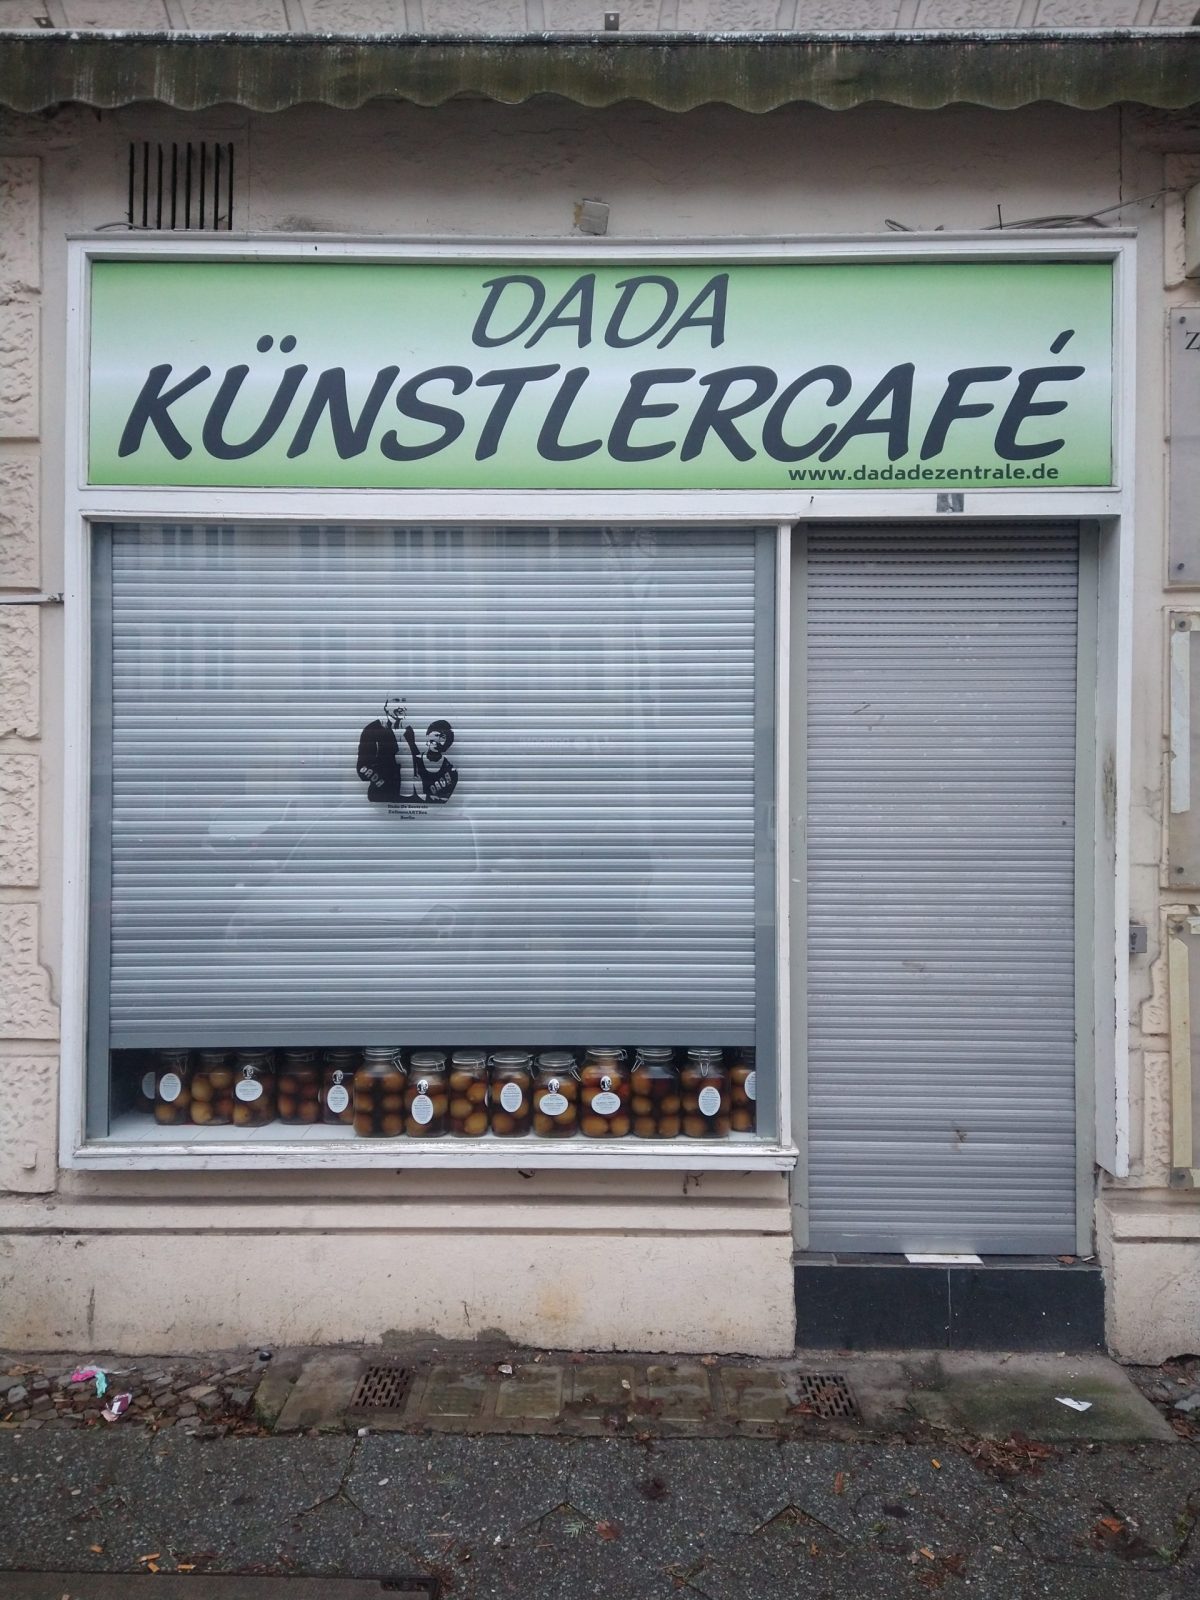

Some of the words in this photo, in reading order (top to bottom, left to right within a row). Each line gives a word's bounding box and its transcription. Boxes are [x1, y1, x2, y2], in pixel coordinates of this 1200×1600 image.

[472, 273, 729, 349] DADA
[118, 329, 1086, 463] KÜNSTLERCAFÉ
[788, 463, 1059, 481] www.dadadezentrale.de
